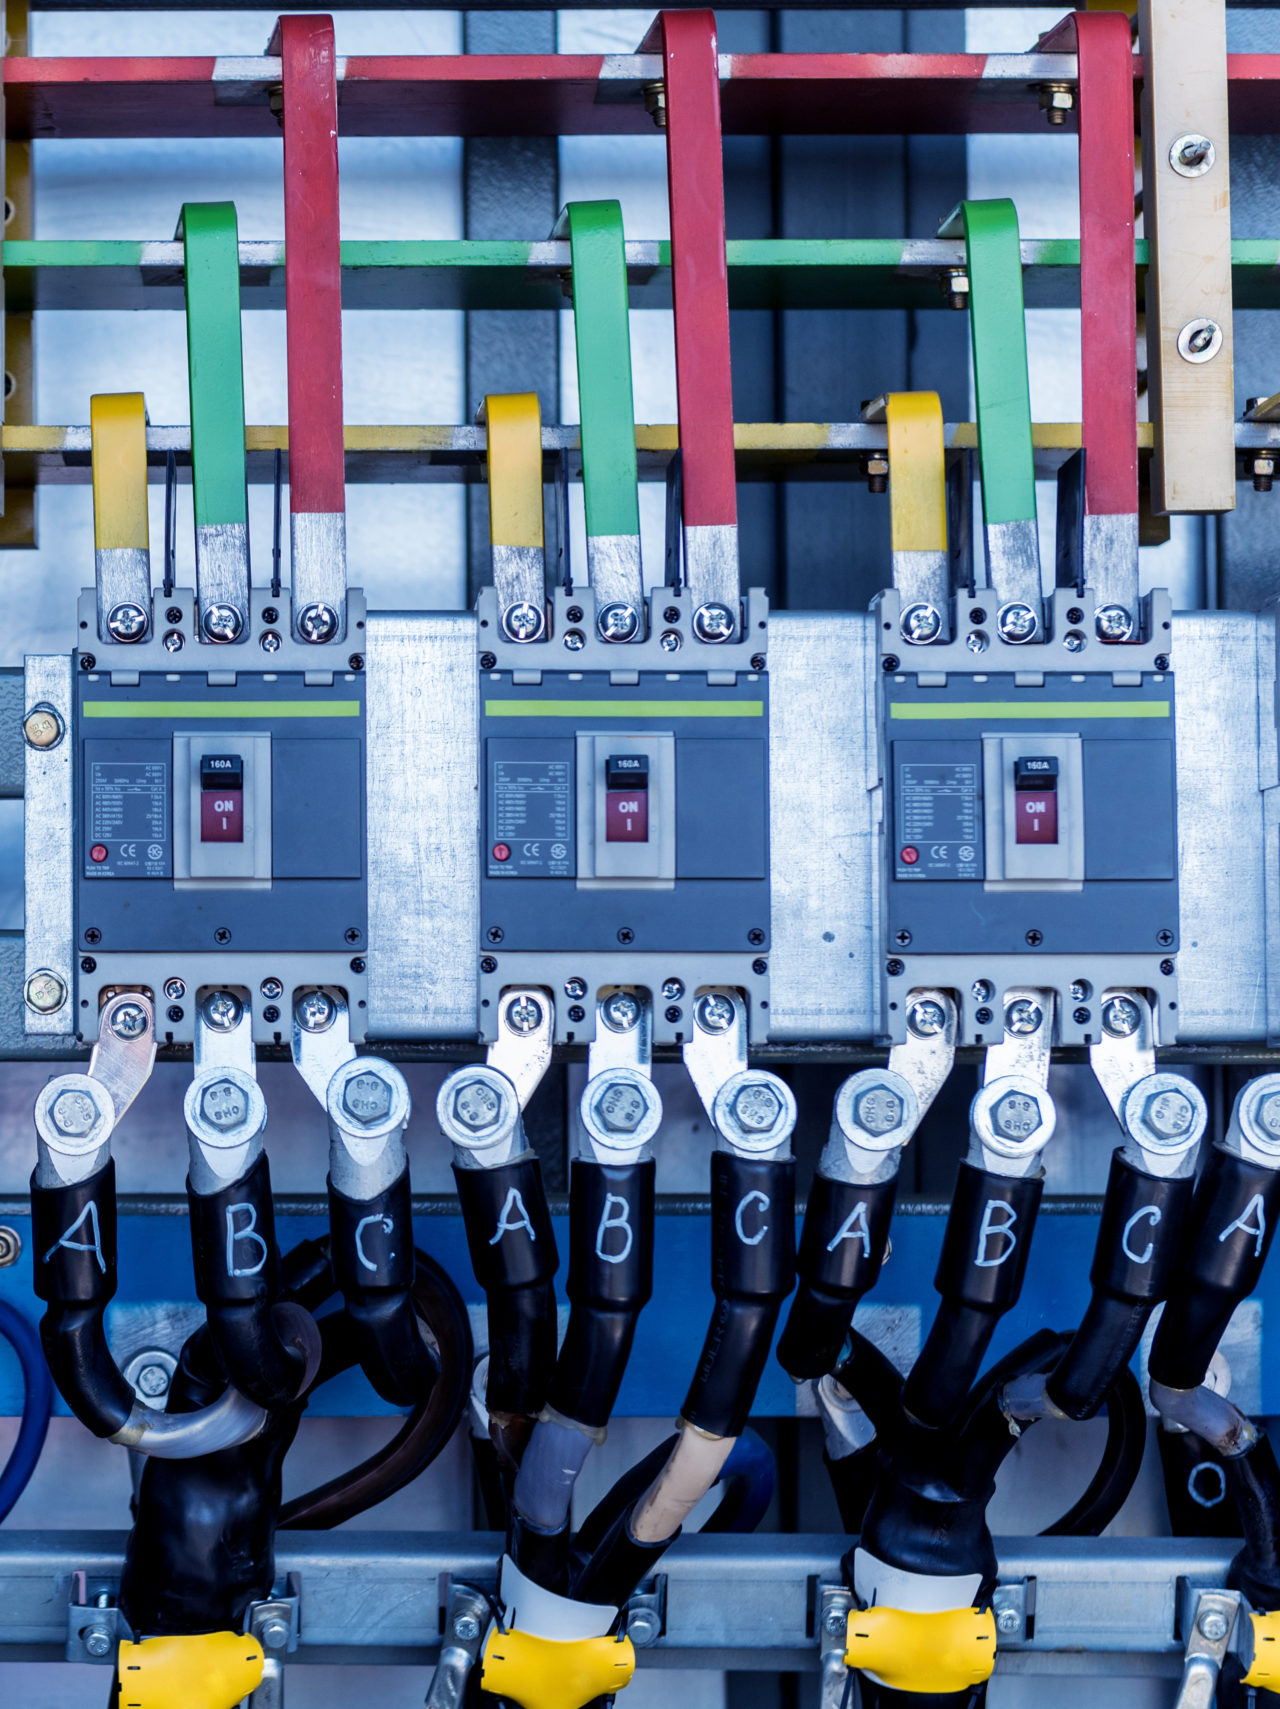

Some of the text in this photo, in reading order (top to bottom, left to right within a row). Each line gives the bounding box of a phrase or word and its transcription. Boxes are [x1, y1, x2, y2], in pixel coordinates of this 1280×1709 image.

[210, 760, 232, 768] 160A
[214, 800, 233, 812] ON
[618, 801, 638, 813] ON
[1026, 802, 1046, 813] ON
[120, 844, 136, 857] CE
[523, 843, 540, 856] CE
[931, 846, 948, 859] CE
[1004, 1119, 1031, 1131] CHS
[46, 1200, 106, 1273] A
[226, 1203, 267, 1277] B
[356, 1213, 395, 1271] C
[490, 1187, 535, 1244] A
[596, 1192, 632, 1263] B
[735, 1190, 770, 1245] C
[827, 1201, 870, 1257] A
[974, 1200, 1017, 1267] B
[1122, 1205, 1161, 1264] C
[1219, 1192, 1266, 1258] A
